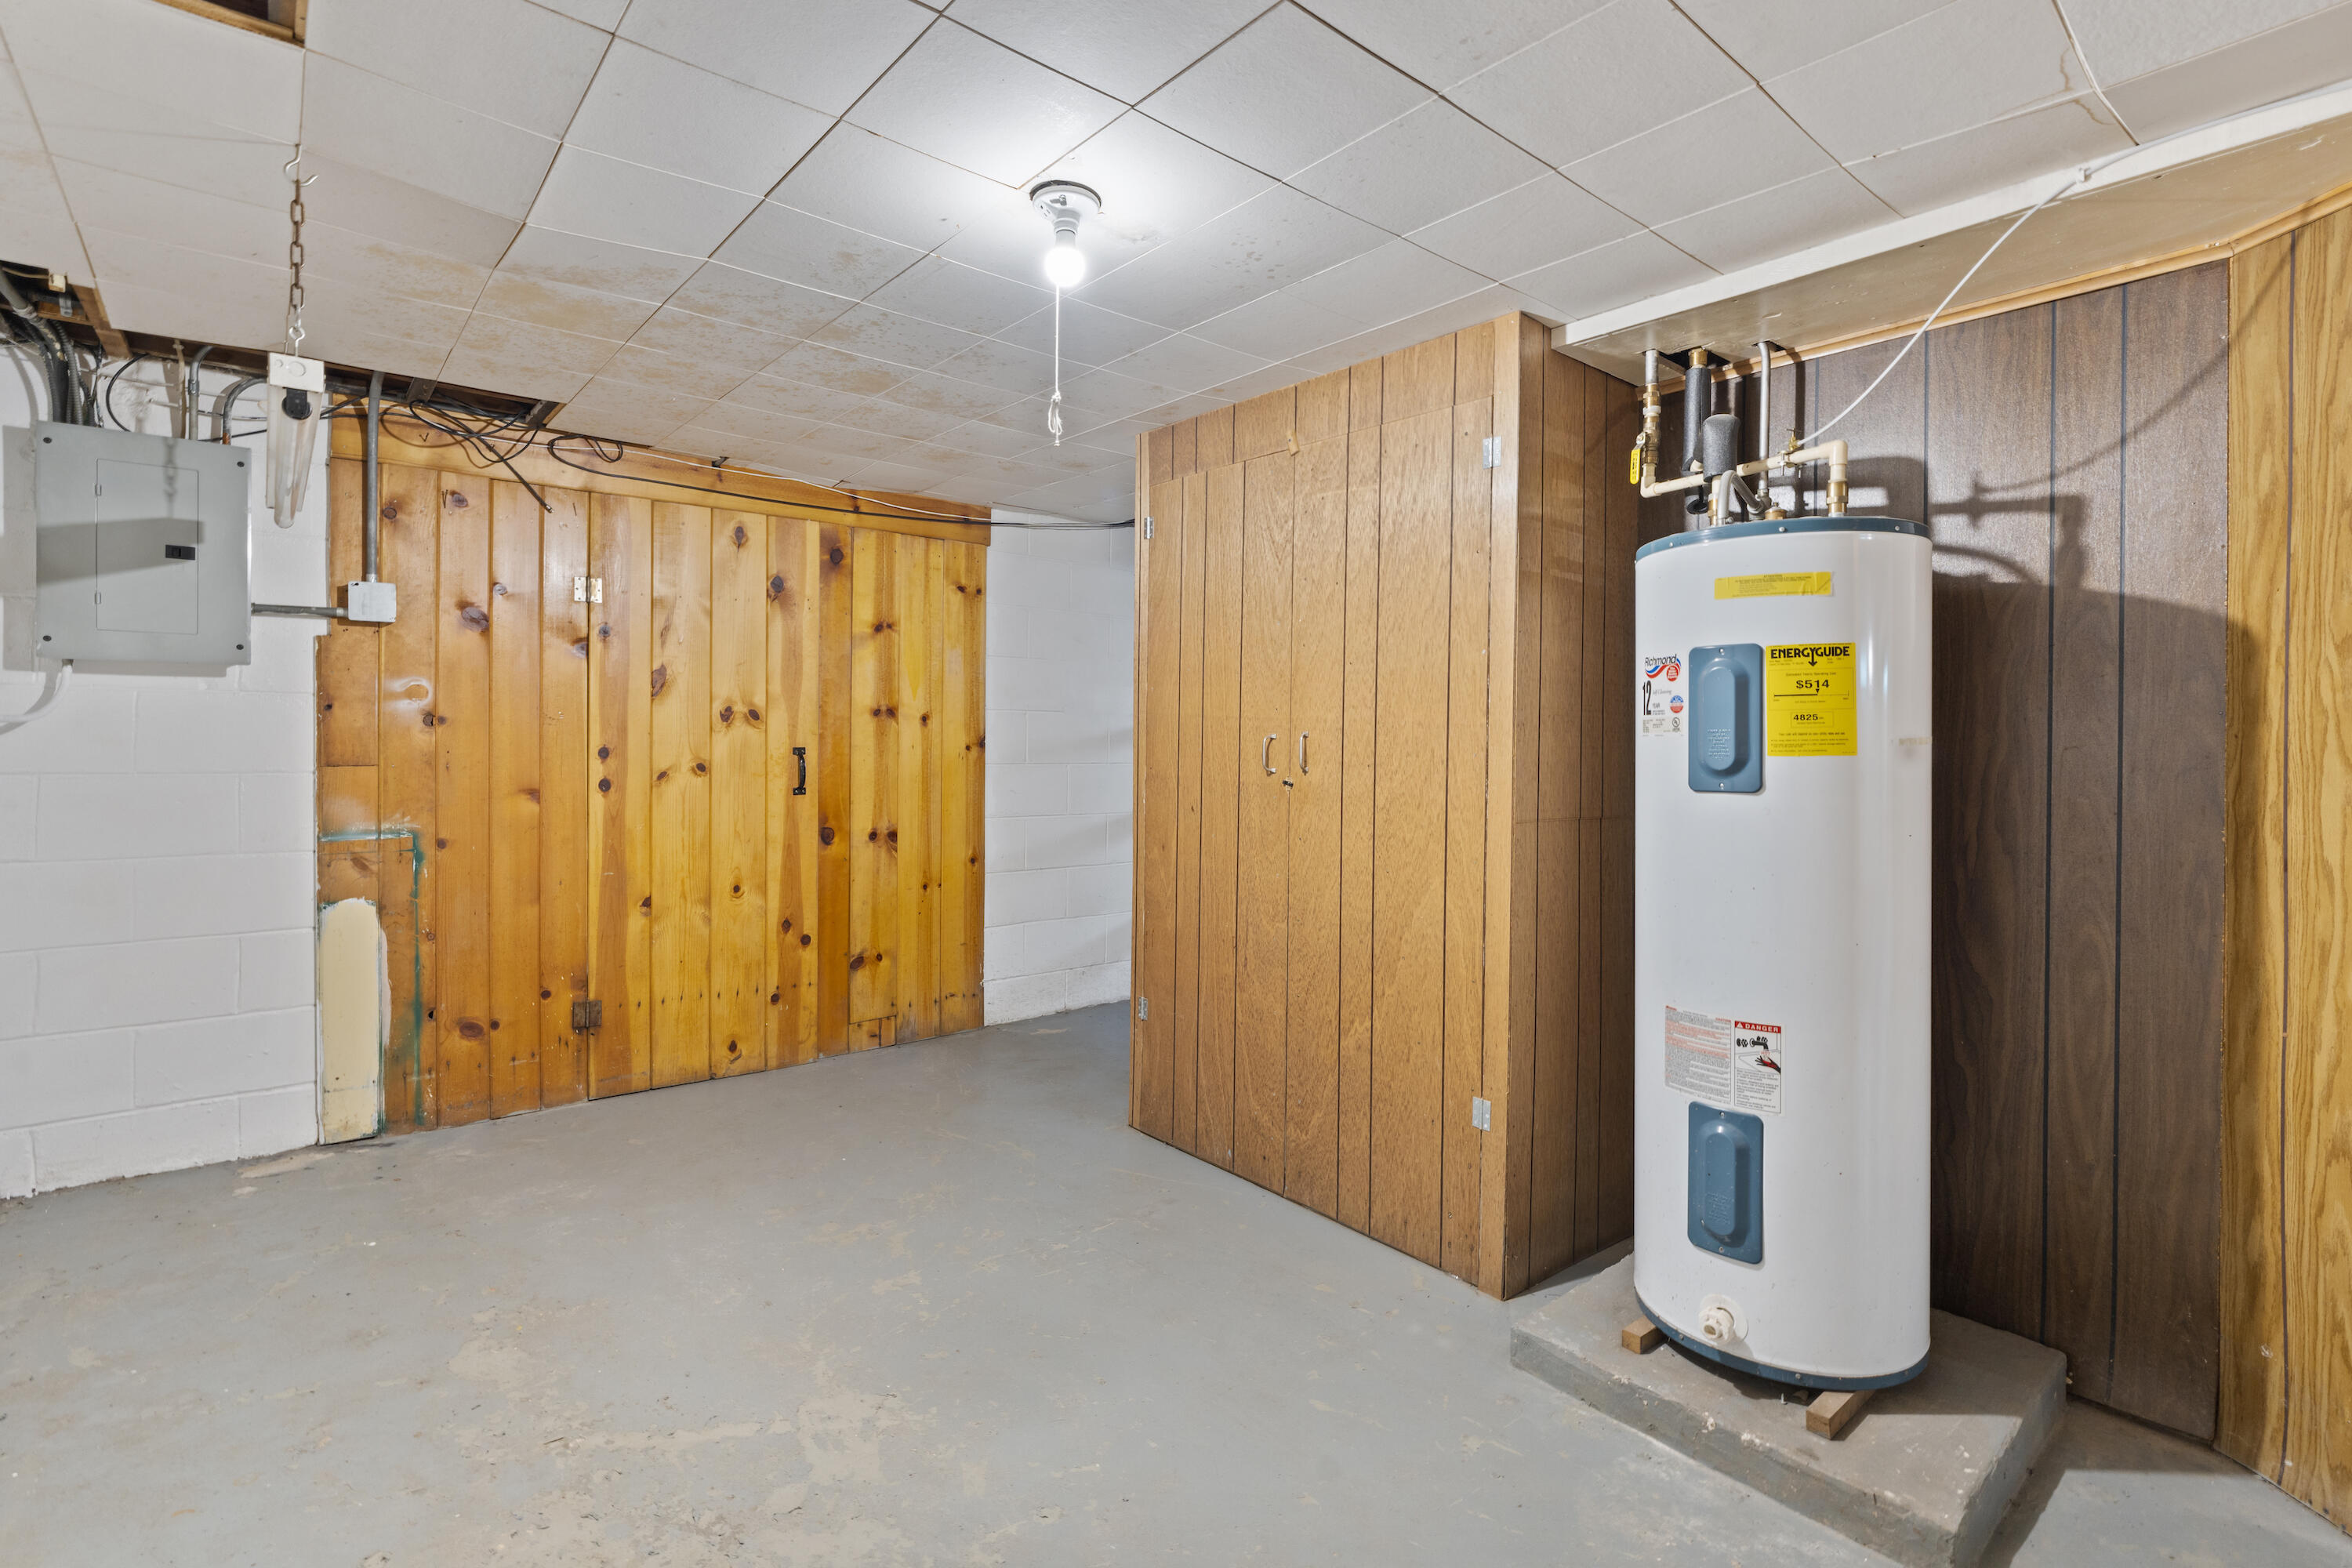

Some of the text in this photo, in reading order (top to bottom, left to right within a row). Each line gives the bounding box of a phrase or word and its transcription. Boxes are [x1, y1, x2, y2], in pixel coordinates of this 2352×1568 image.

[1771, 646, 1850, 659] ENERGYGUIDE
[1645, 653, 1677, 666] Richmond
[1796, 679, 1829, 689] $514
[1642, 680, 1652, 716] 12
[1745, 1023, 1779, 1033] DANGER
